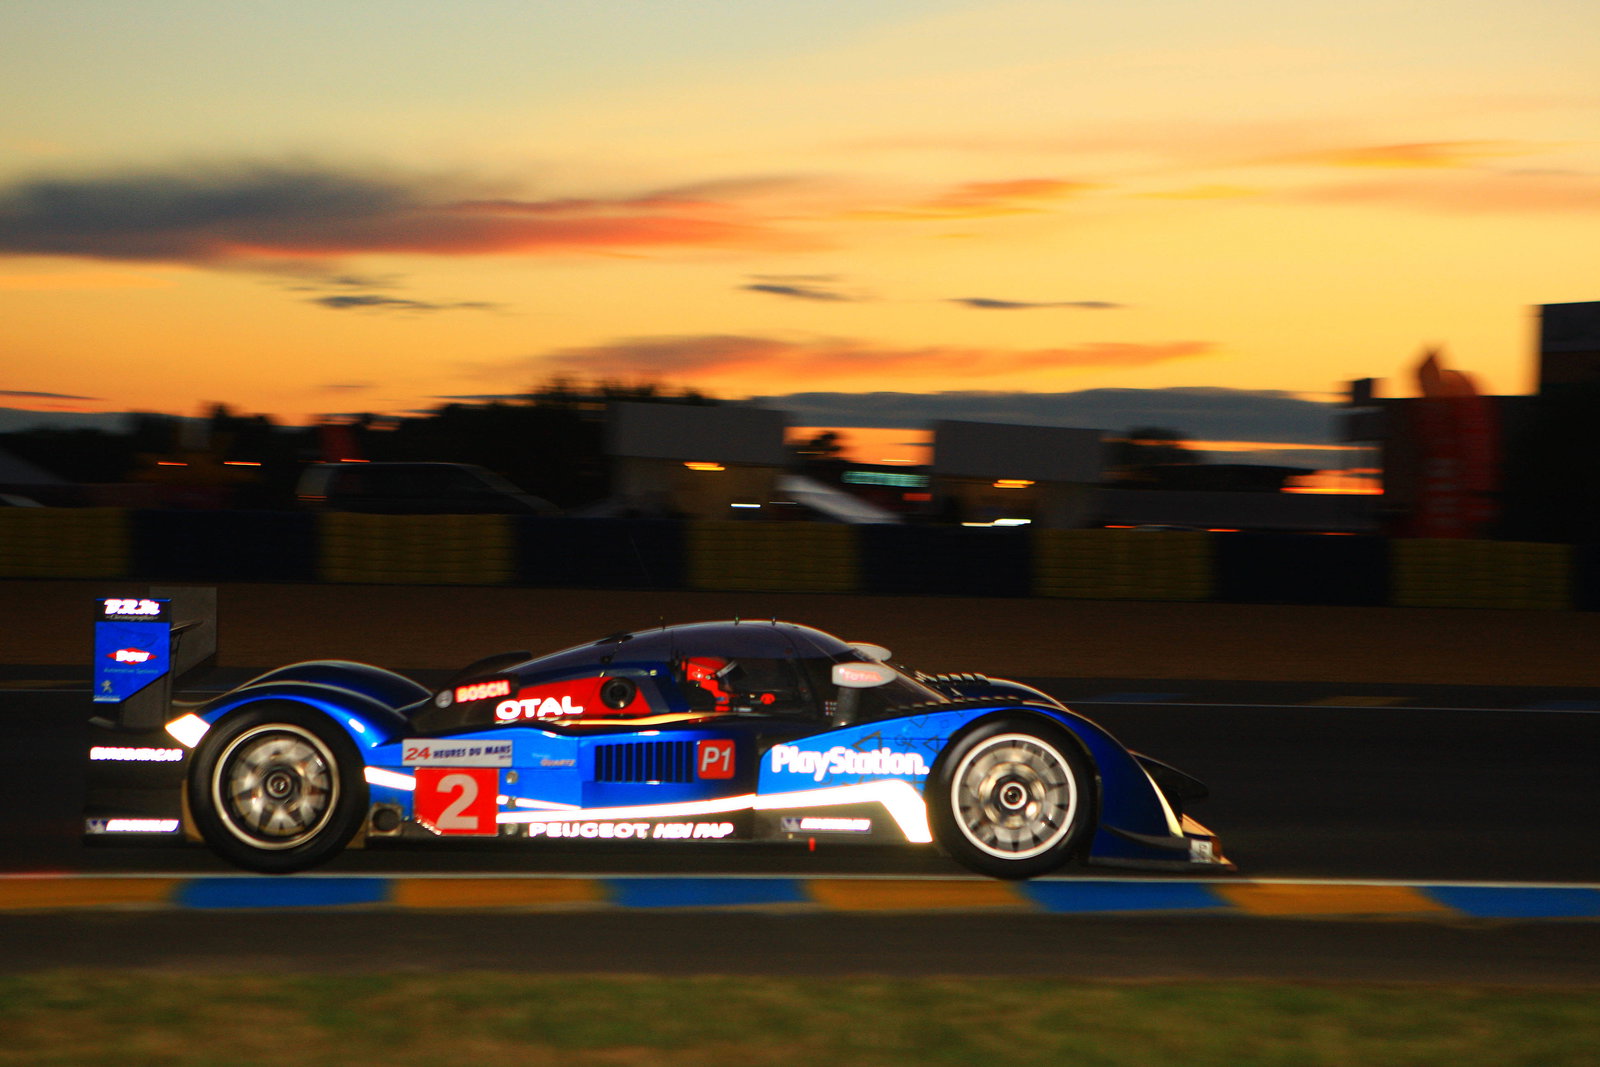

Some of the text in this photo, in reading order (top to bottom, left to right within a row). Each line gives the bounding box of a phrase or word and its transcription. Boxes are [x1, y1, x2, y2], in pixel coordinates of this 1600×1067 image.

[455, 680, 510, 703] BOSCH
[404, 744, 511, 761] 24 HEURES DU MANS
[701, 747, 732, 772] P1
[435, 774, 478, 830] 2
[529, 822, 650, 839] PEUGEOT
